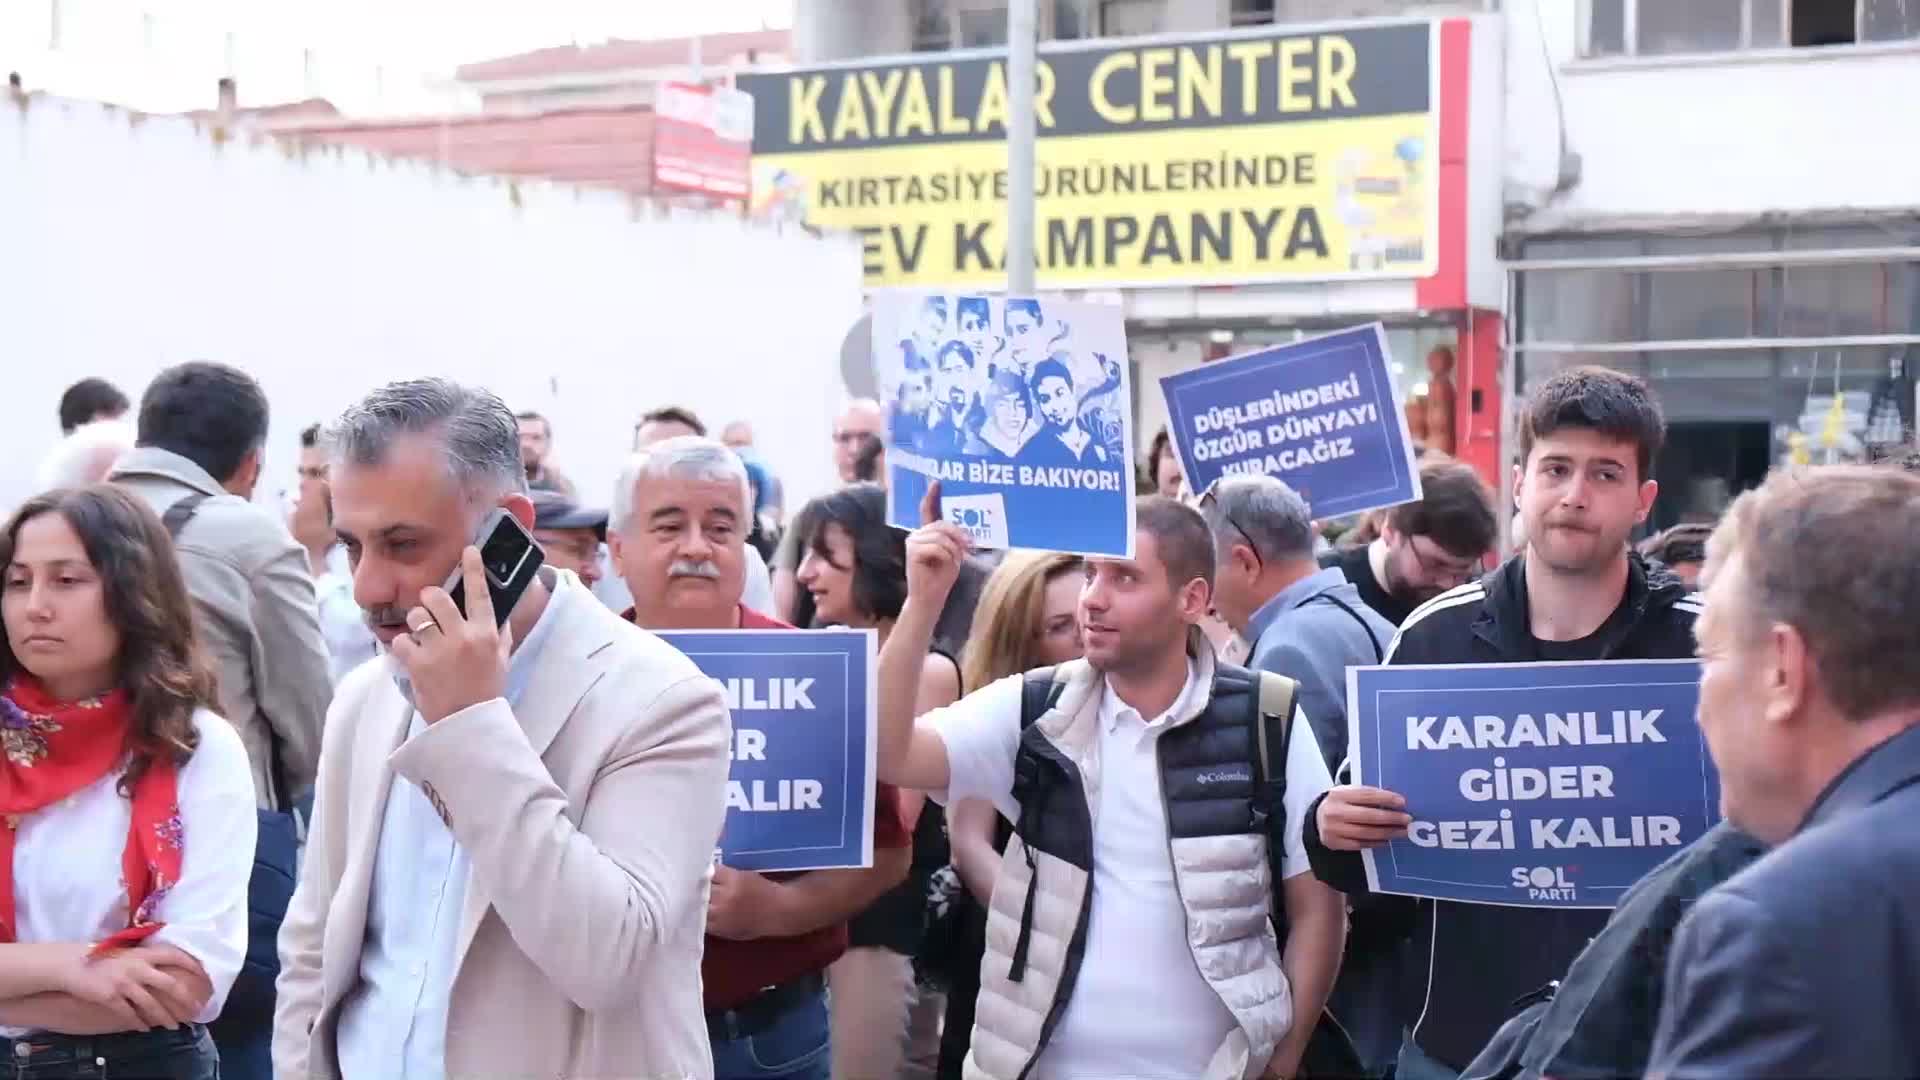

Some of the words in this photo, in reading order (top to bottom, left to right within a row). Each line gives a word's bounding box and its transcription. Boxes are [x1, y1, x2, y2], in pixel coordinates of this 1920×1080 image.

[788, 59, 1056, 144] KAYALAR
[1088, 34, 1358, 124] CENTER
[855, 222, 928, 273] EV
[1194, 372, 1361, 435] DÜŞLERİNDEKİ
[1193, 429, 1264, 462] ÖZGÜR
[1266, 402, 1378, 446] DÜNYAYI
[931, 458, 965, 482] LAR
[968, 459, 1015, 485] BİZE
[1019, 464, 1121, 492] BAKIYOR!
[712, 678, 815, 709] NLIK
[1406, 709, 1667, 750] KARANLIK
[726, 780, 823, 811] ALIR
[1458, 757, 1615, 802] GİDER
[1407, 808, 1515, 850] GEZİ
[1529, 815, 1682, 849] KALIR
[1511, 866, 1576, 889] SOL
